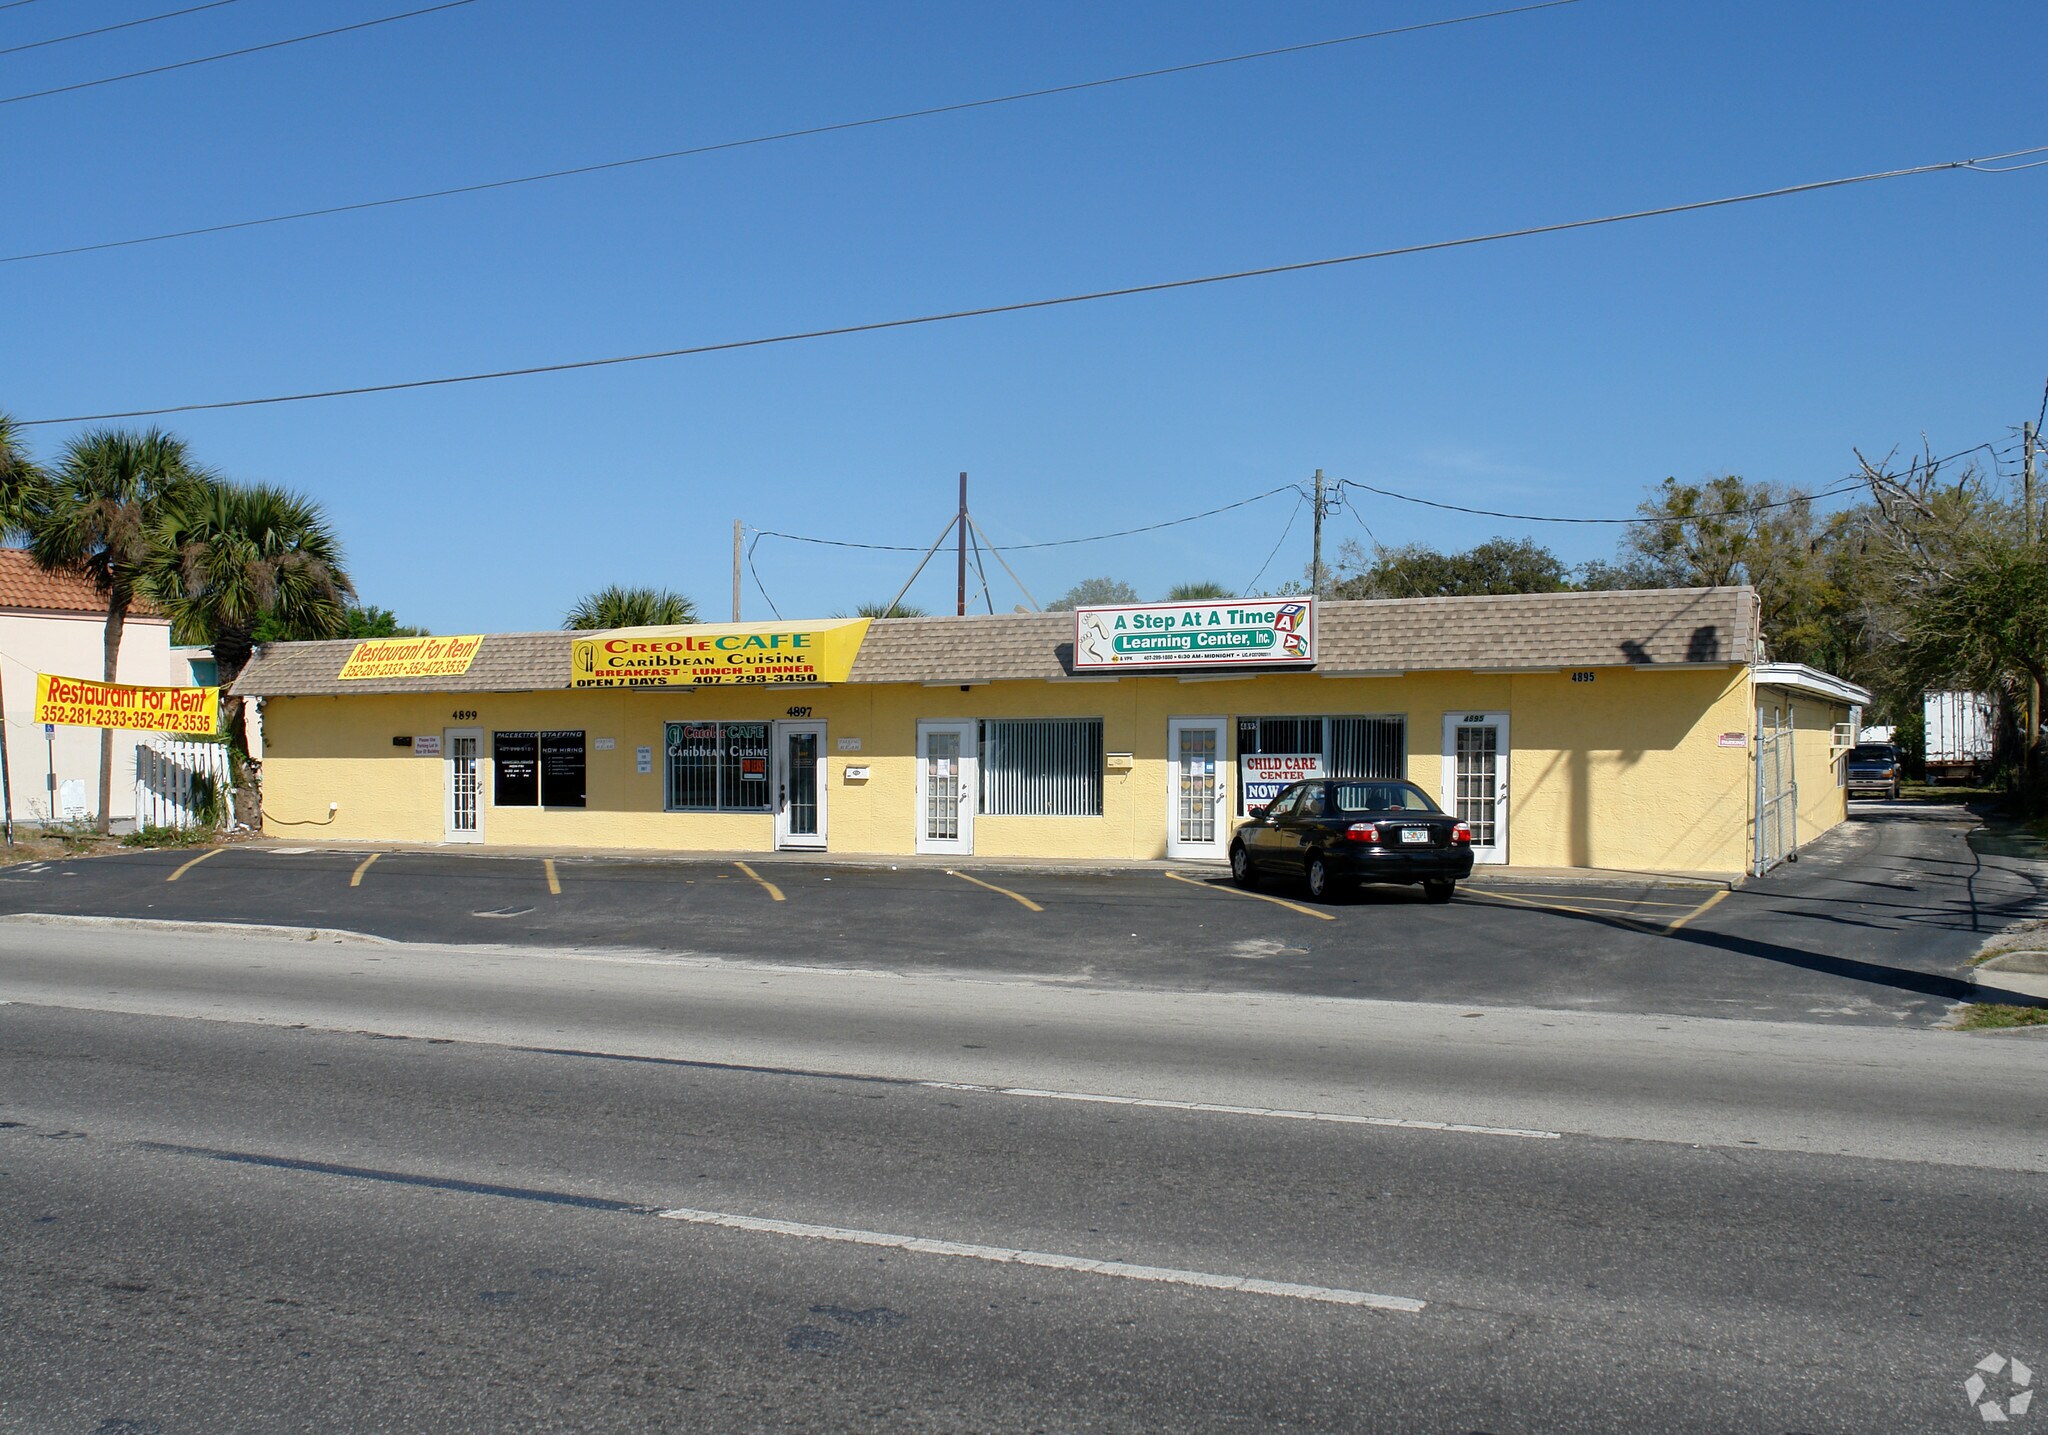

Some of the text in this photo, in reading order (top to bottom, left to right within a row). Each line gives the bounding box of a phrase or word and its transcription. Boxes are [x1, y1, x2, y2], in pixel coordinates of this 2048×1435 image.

[1114, 610, 1275, 631] A Step At A Time
[715, 633, 811, 651] CAFE
[1122, 631, 1270, 649] Learning Center, Inc.
[352, 637, 480, 662] Restaurant For Rent
[595, 668, 680, 677] BREAKFAST
[692, 667, 743, 675] LUNCH
[754, 665, 814, 674] DINNER
[1571, 671, 1595, 682] 4895
[576, 678, 613, 687] OPEN
[617, 678, 625, 686] 7
[629, 677, 667, 686] DAYS
[693, 675, 722, 684] 407
[735, 674, 818, 683] 293-3450
[47, 677, 207, 713] Restaurant For Rent
[452, 710, 477, 720] 4899
[786, 706, 812, 717] 4897
[727, 725, 765, 739] CAFE
[1247, 757, 1316, 770] CHILD CARE
[1260, 771, 1305, 779] CENTER
[1248, 785, 1279, 798] NOW
